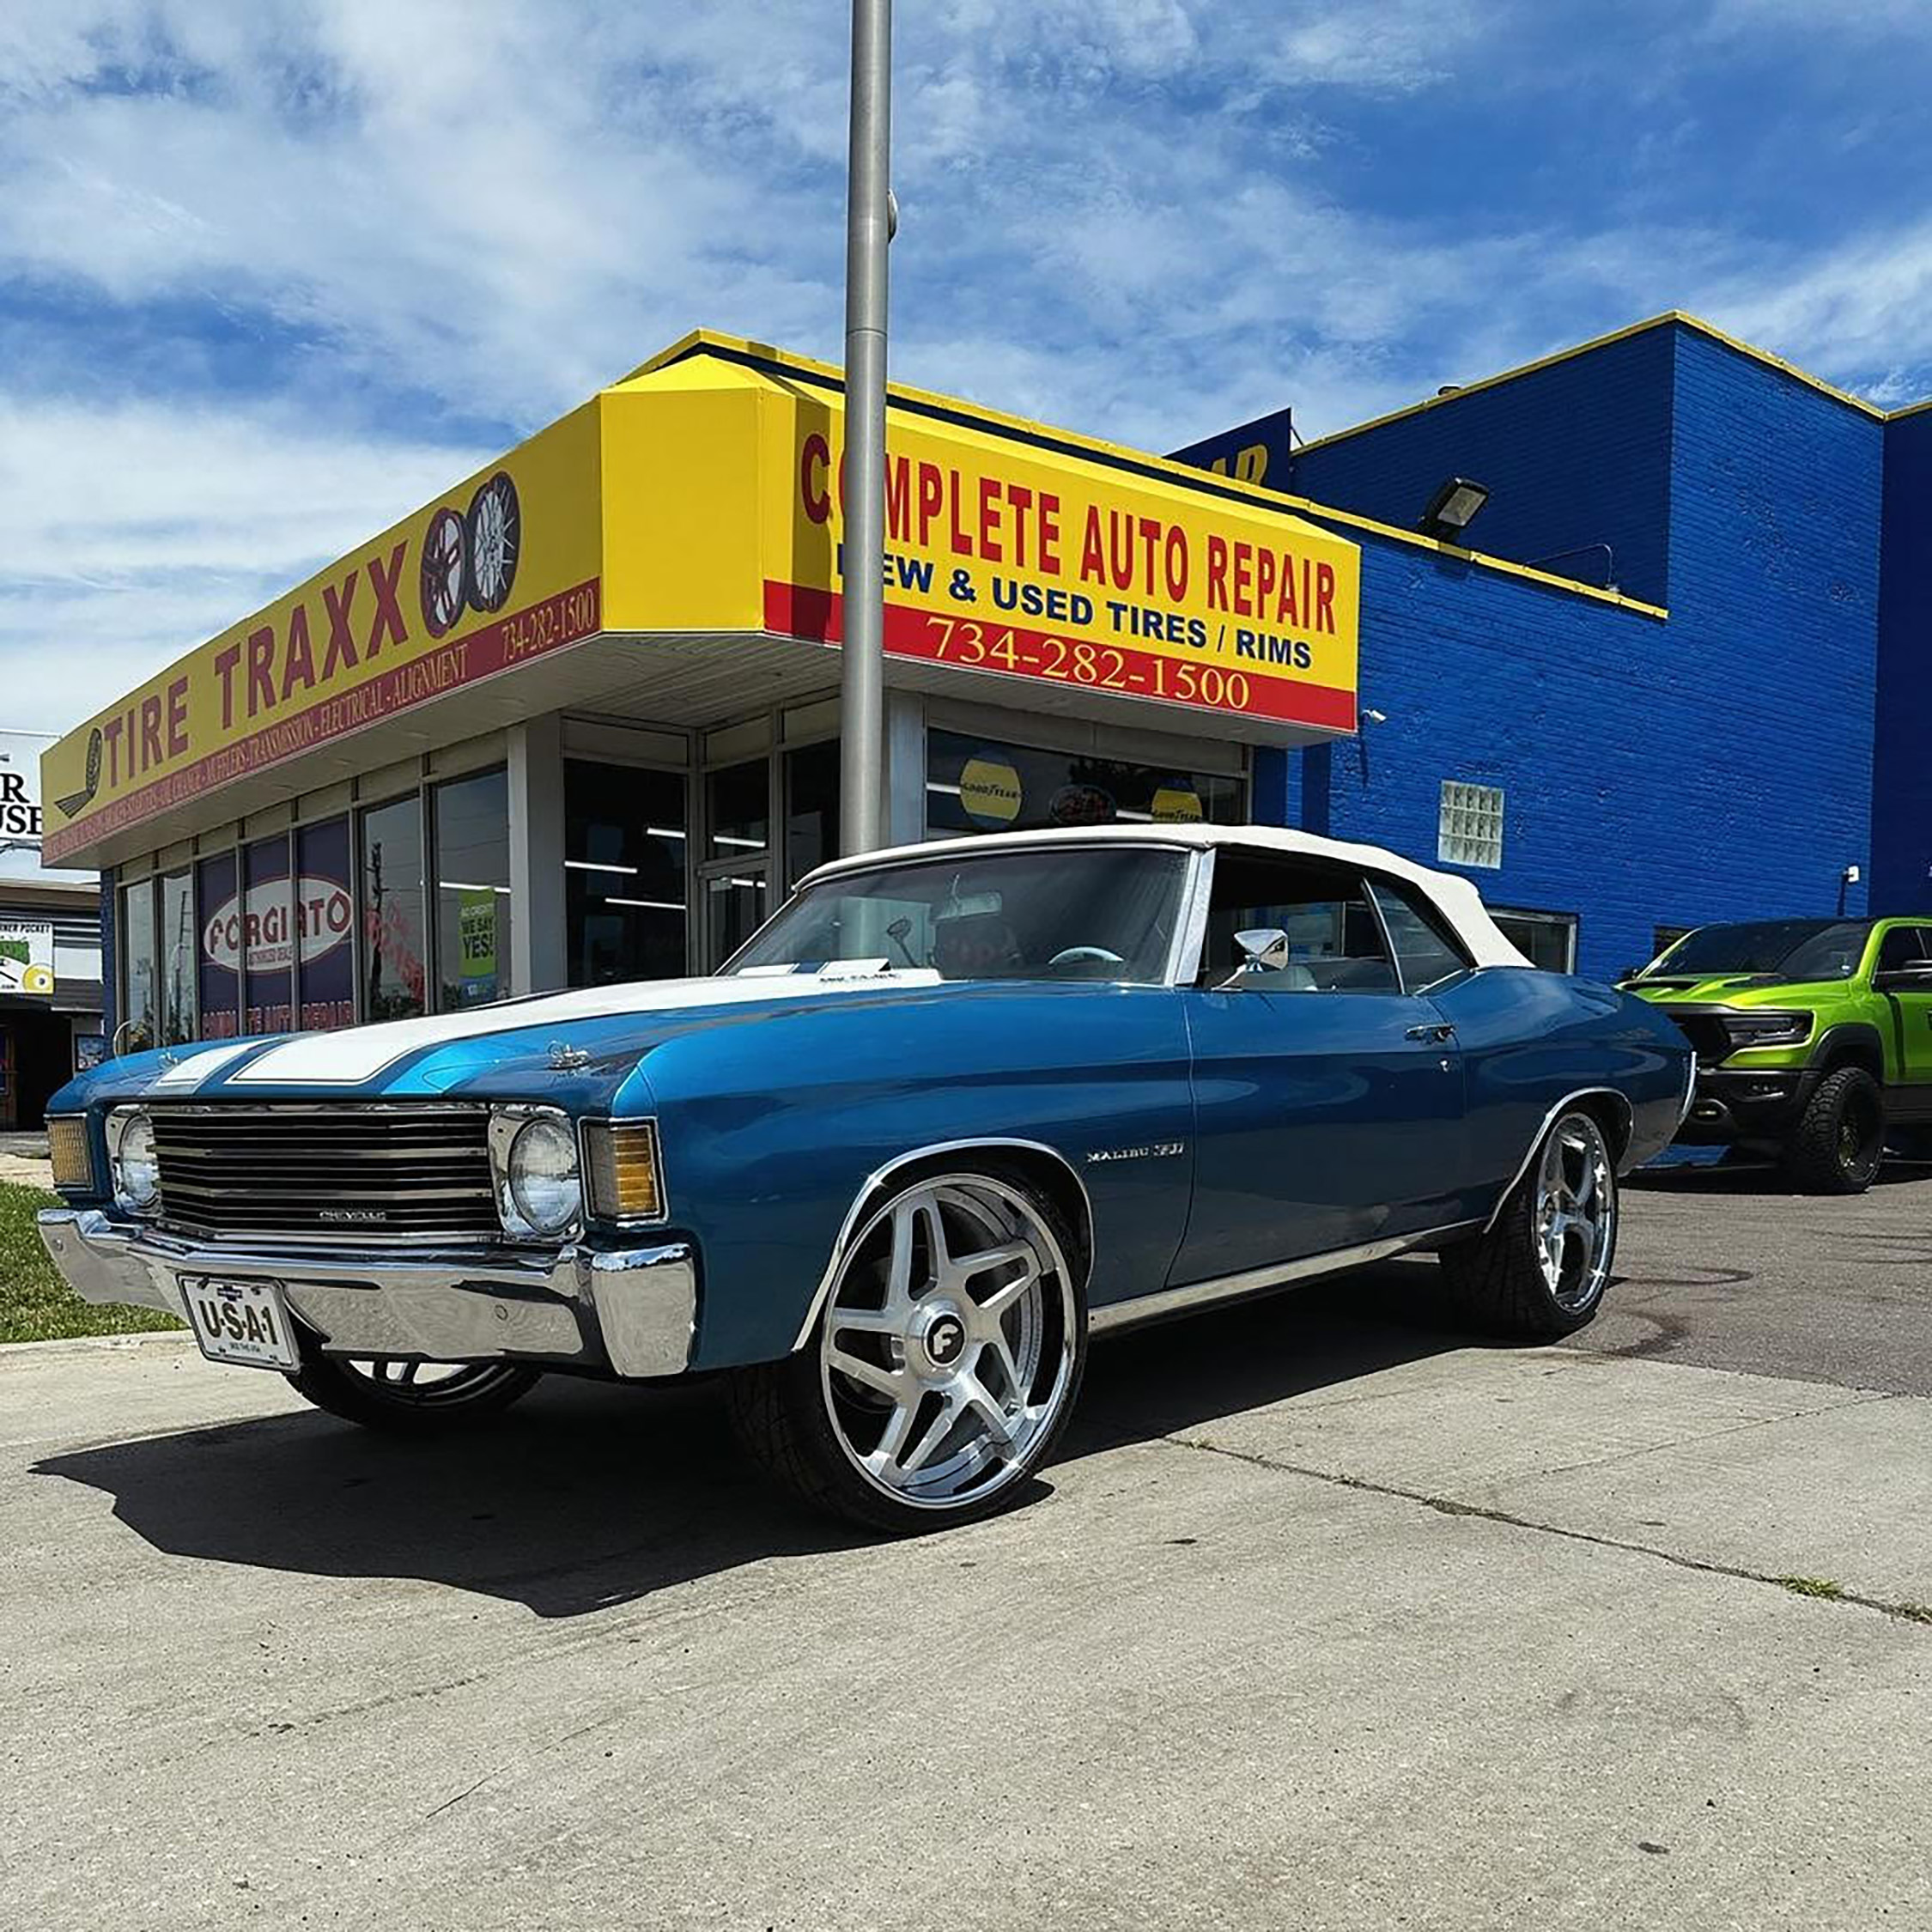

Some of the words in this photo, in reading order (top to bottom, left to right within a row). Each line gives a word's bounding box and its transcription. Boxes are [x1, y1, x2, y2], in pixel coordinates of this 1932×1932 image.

[801, 433, 1061, 574] CMPLETE
[1080, 504, 1188, 604] AUTO
[1207, 534, 1336, 635] REPAIR
[837, 544, 934, 592] EW
[948, 568, 978, 602] &
[992, 576, 1094, 625] USED
[1106, 600, 1207, 648] TIRES
[1236, 629, 1312, 669] RIMS
[104, 674, 189, 788] TIRE
[214, 538, 409, 730] TRAXX
[320, 682, 385, 735] ELECTRICAL
[392, 643, 468, 708] ALIGNMENT
[501, 587, 595, 663] 734-282-1500
[926, 617, 1250, 711] 734-282-1500
